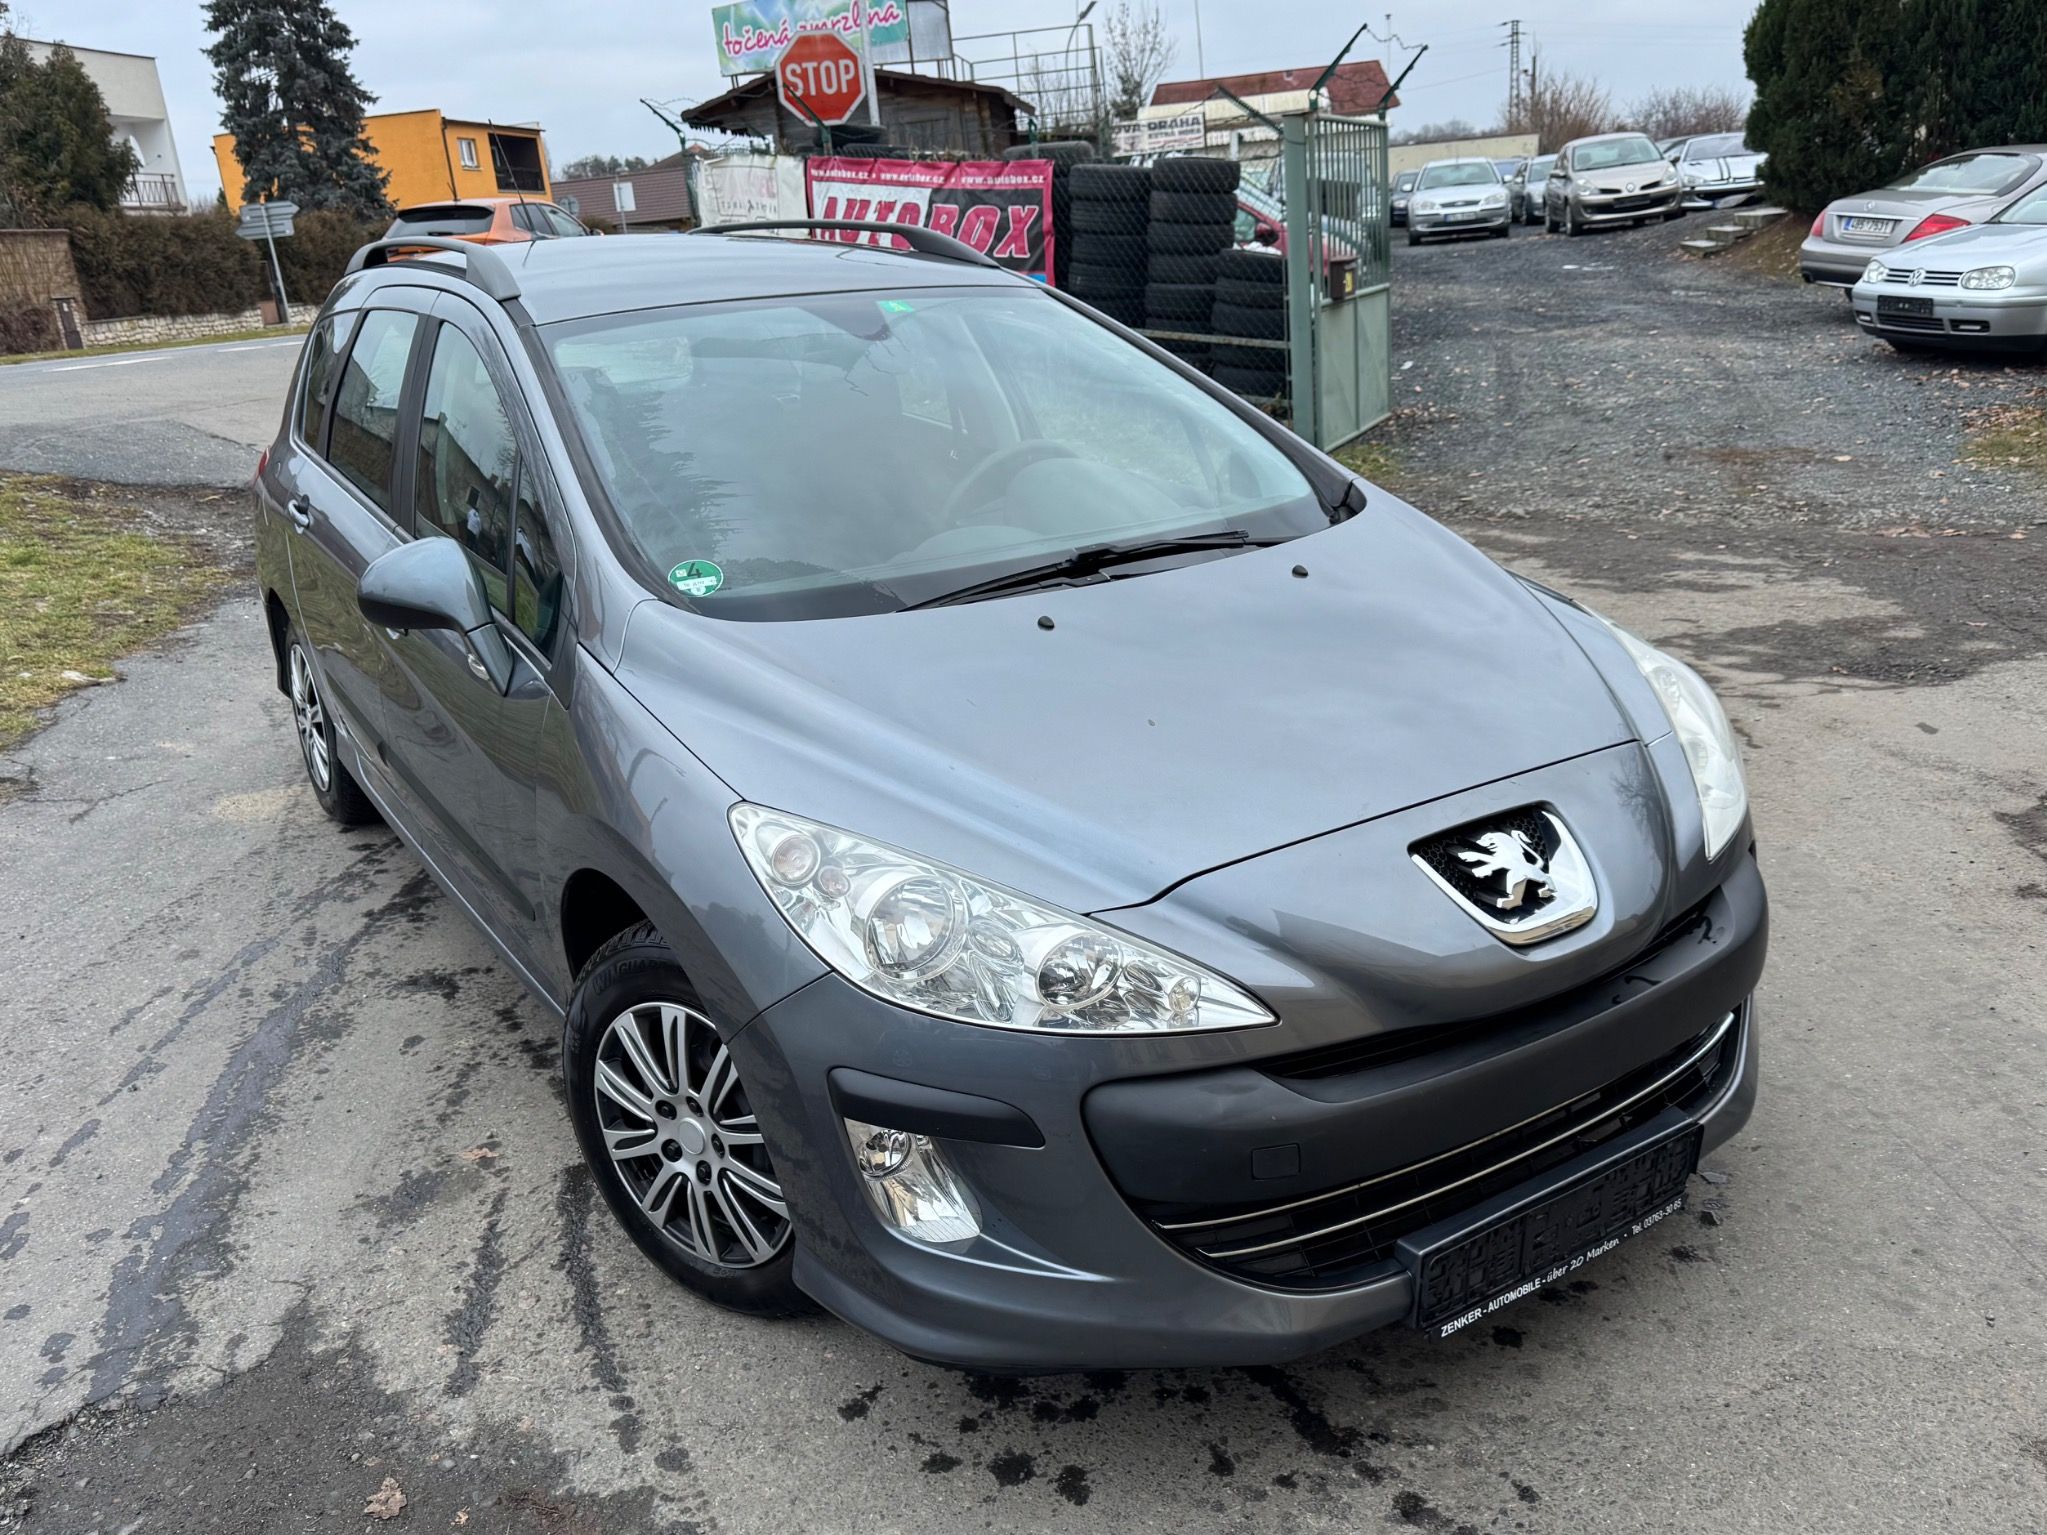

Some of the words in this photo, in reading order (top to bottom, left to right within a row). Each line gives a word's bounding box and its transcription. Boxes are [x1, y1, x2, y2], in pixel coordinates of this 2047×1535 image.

[724, 19, 791, 56] točená
[785, 59, 856, 97] STOP
[961, 174, 1045, 185] www.autobox.cz
[1570, 1256, 1584, 1270] 20
[1586, 1238, 1619, 1261] Marken
